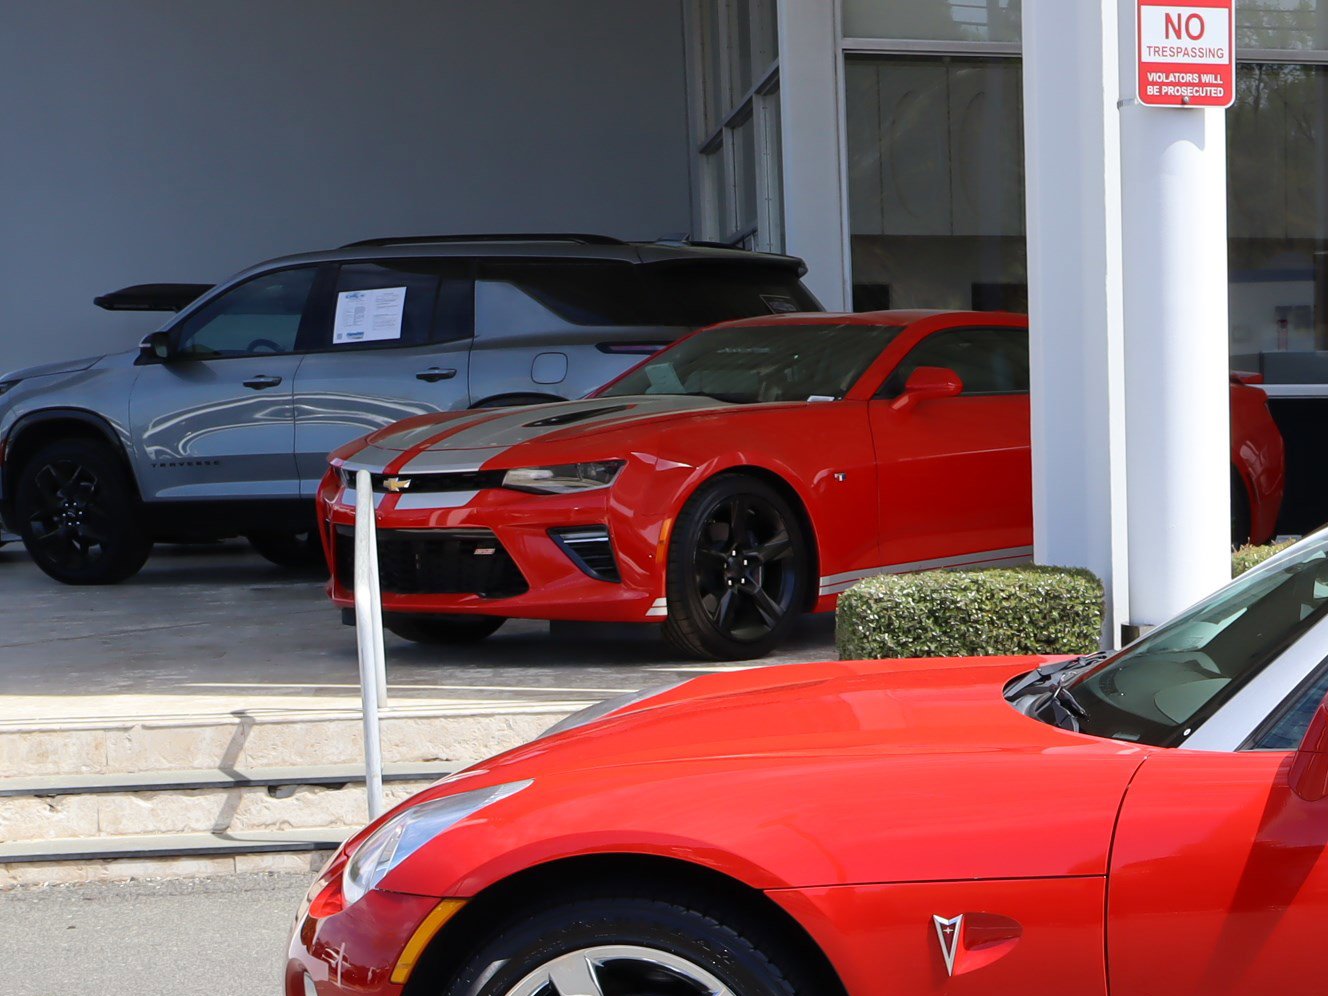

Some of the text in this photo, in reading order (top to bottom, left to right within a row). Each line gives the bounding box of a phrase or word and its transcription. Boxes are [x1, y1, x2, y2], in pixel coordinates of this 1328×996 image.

[1165, 13, 1205, 40] NO
[1147, 46, 1224, 58] TRESPASSING
[1147, 72, 1223, 84] VIOLATORS WILL
[1147, 86, 1224, 97] BE PROSECUTED
